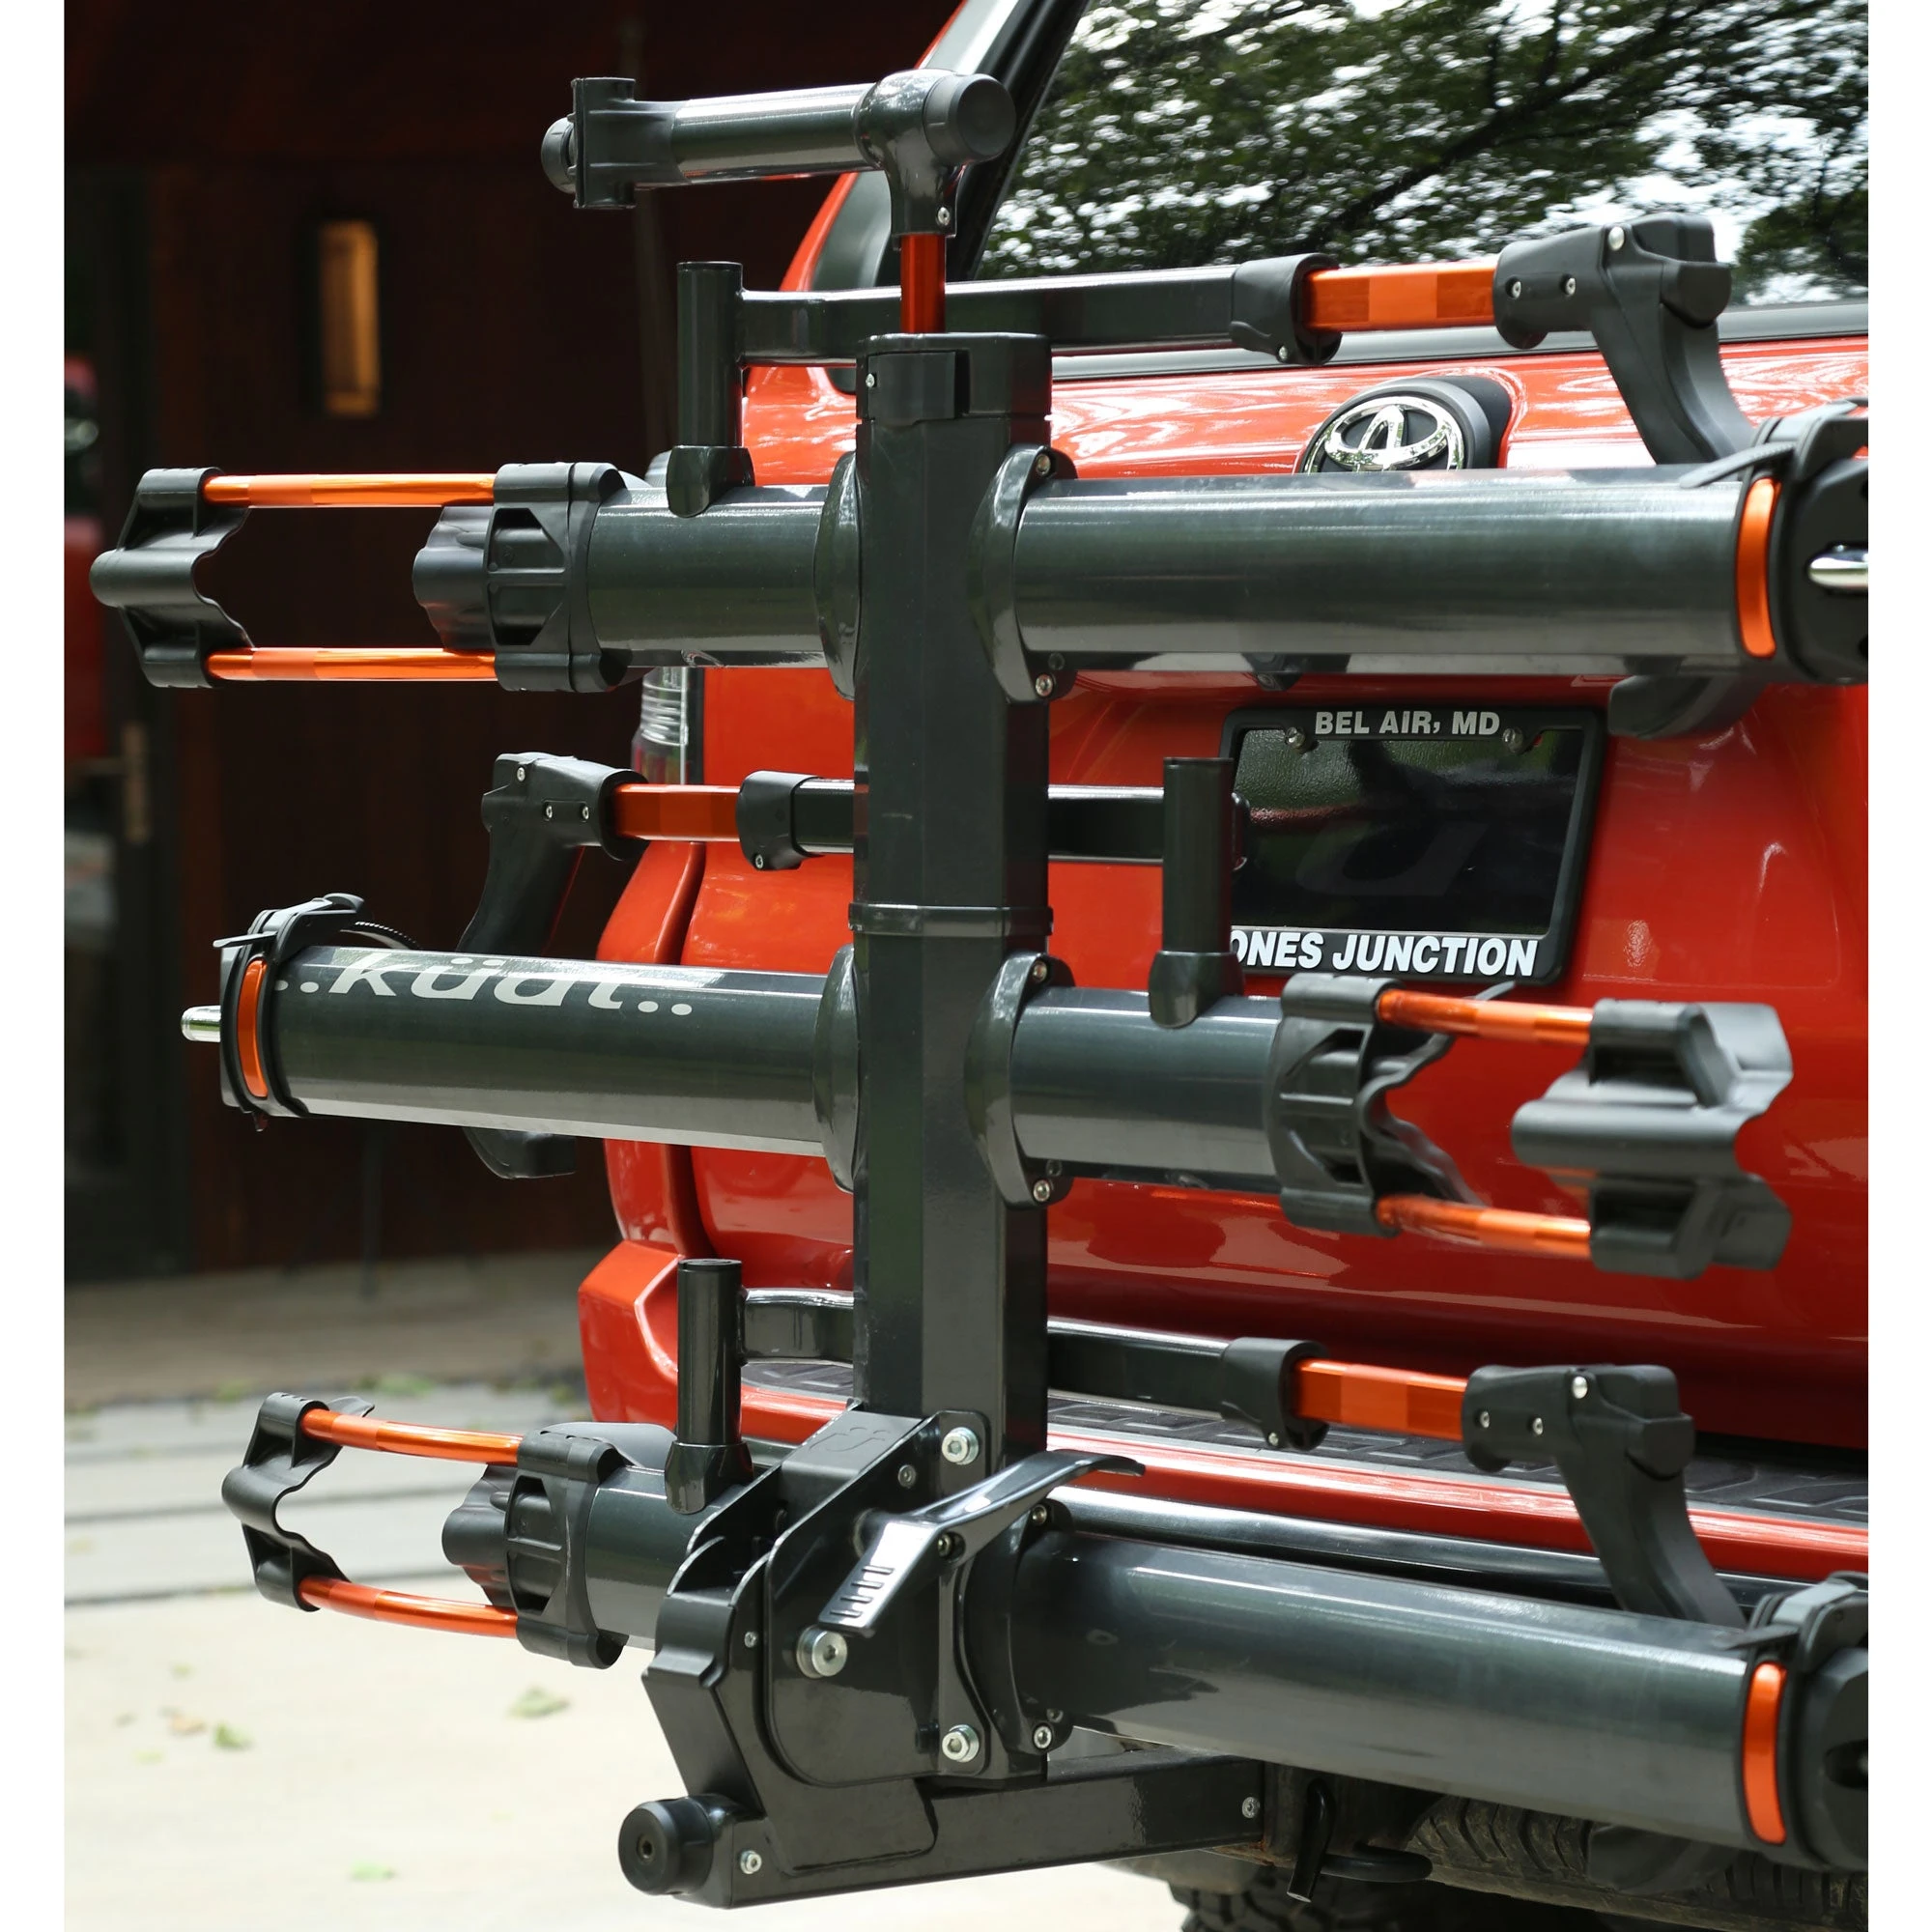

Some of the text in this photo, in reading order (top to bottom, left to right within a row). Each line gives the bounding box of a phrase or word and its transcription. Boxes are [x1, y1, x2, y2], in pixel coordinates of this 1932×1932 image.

[1315, 710, 1500, 735] BEL AIR, MD
[1332, 934, 1538, 977] JUNCTION
